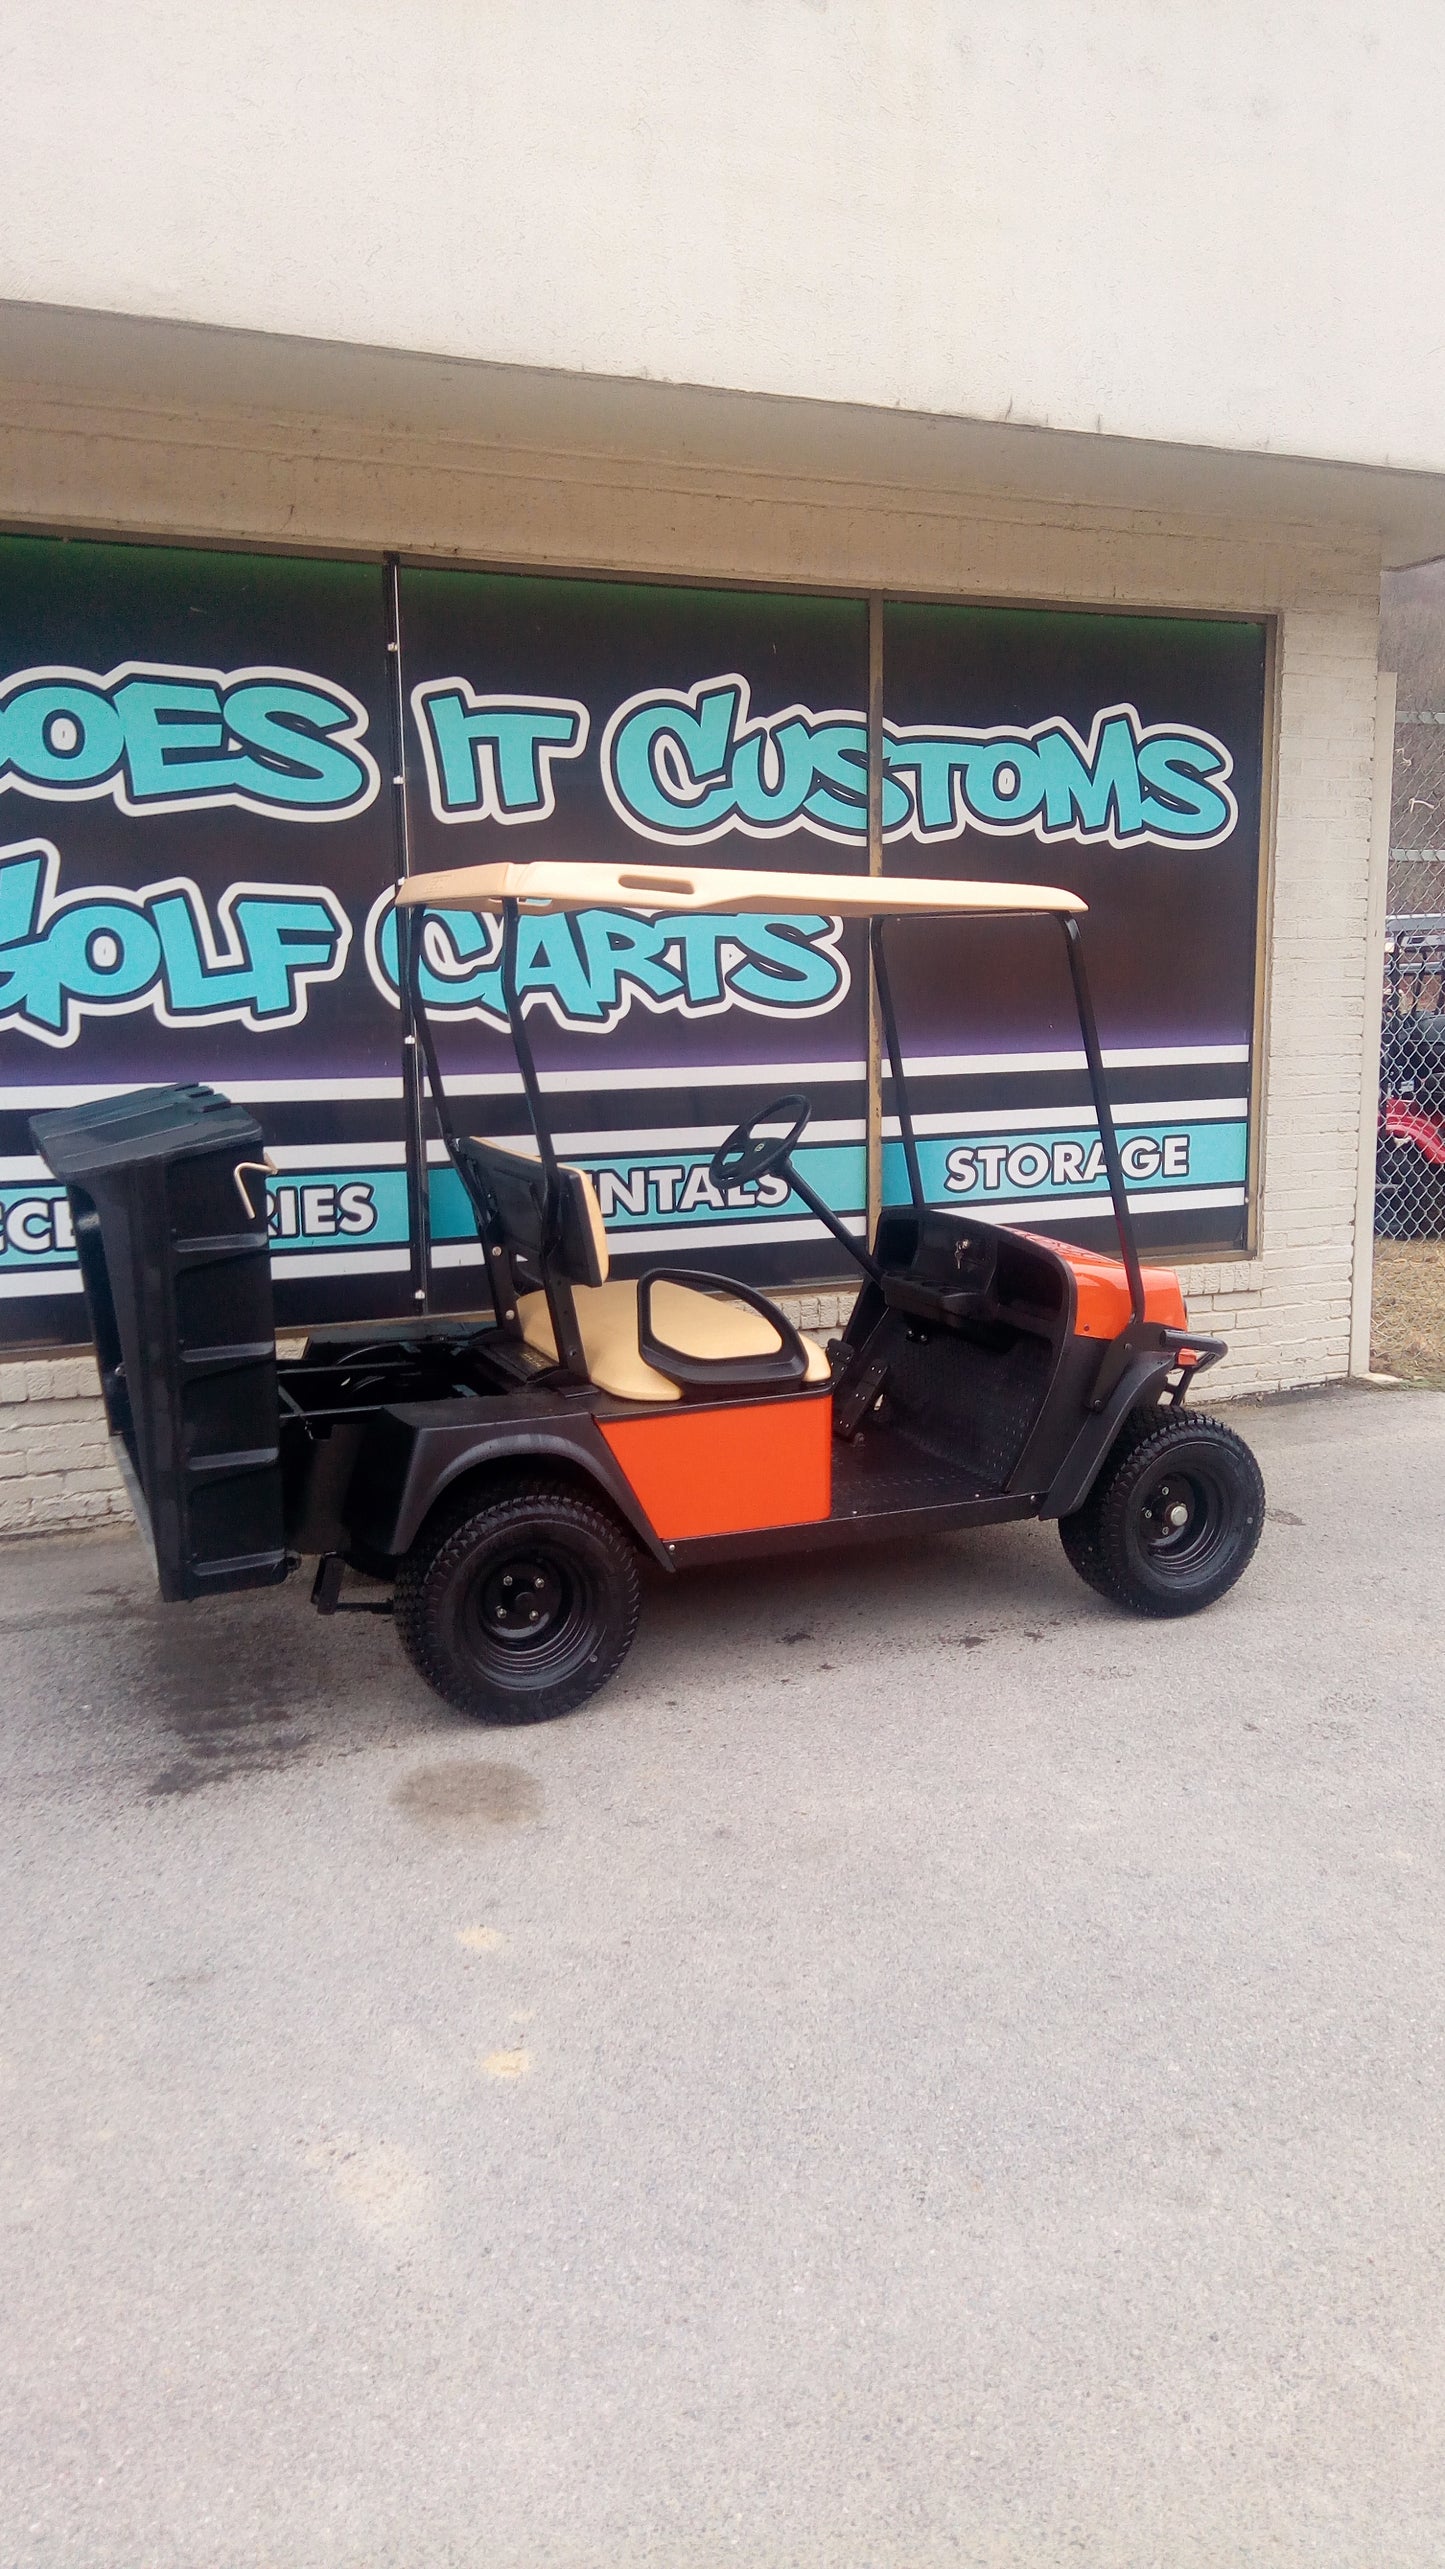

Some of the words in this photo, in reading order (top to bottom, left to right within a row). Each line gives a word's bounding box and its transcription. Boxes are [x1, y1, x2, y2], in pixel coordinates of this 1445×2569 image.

[0, 664, 378, 819] OES
[413, 679, 588, 822] IT
[603, 674, 1236, 848] CUSTOMS
[367, 902, 850, 1032] CARTS
[587, 1164, 791, 1217] NTALS
